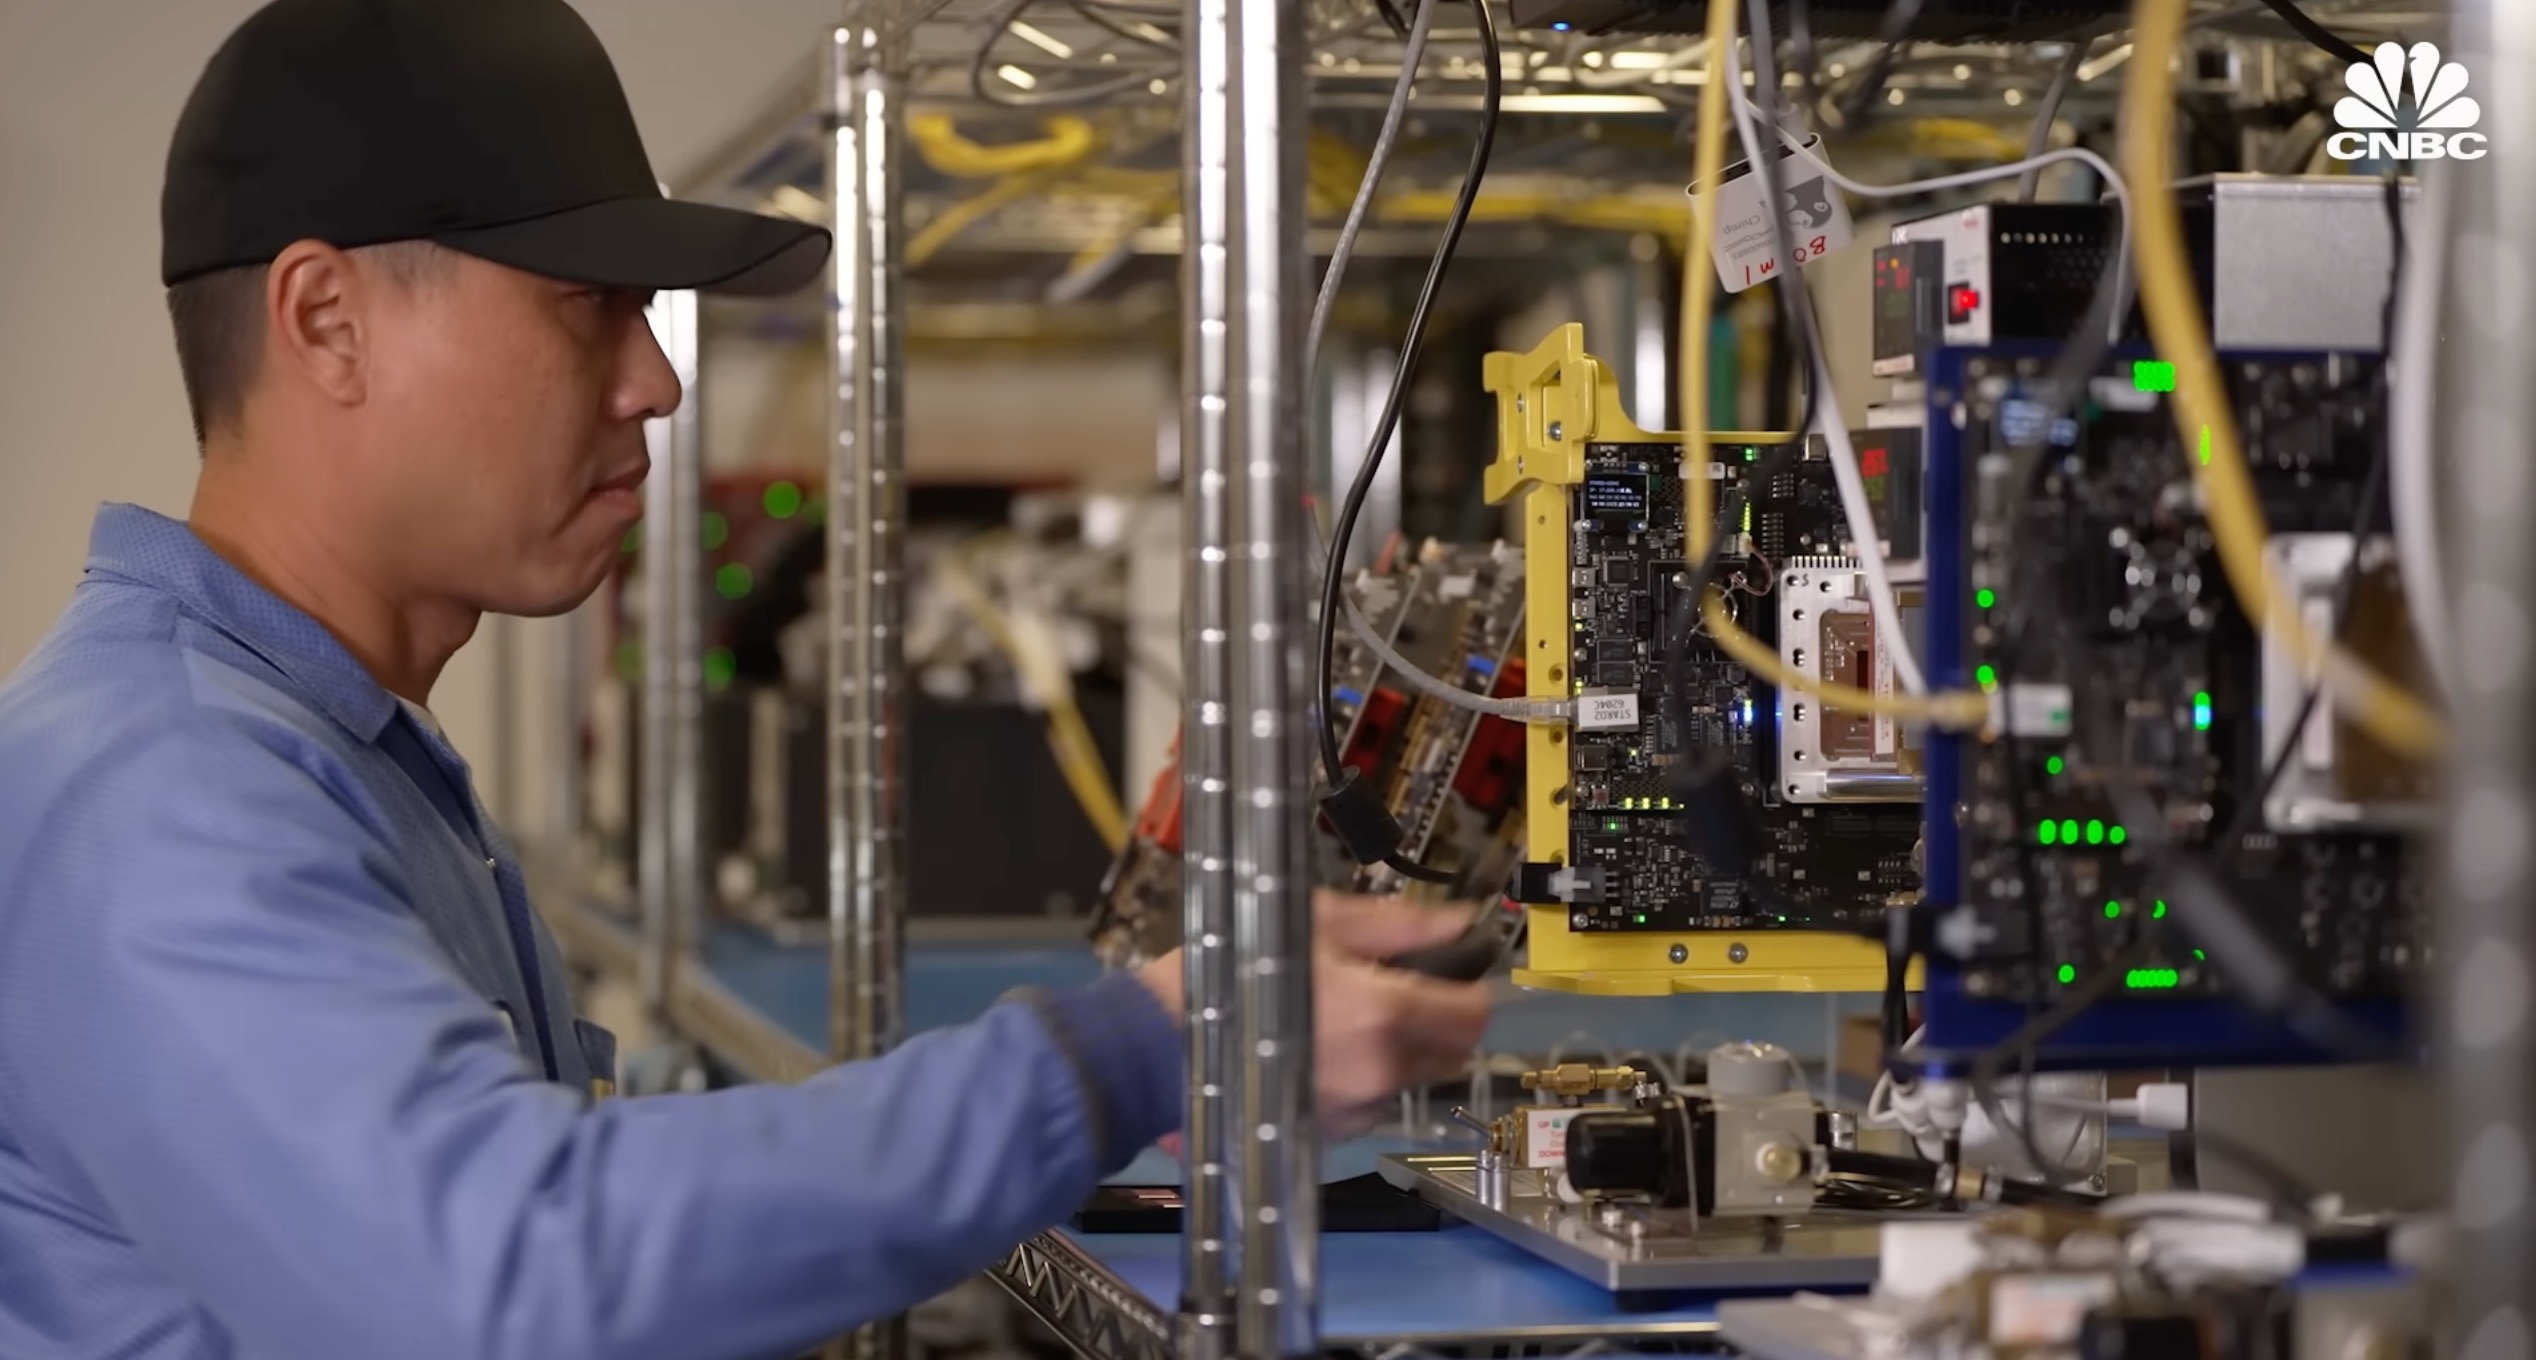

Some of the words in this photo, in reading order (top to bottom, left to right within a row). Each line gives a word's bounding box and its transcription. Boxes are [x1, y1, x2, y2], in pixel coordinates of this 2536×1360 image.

[1723, 214, 1760, 235] Chimp
[1801, 573, 1810, 587] S
[1538, 1120, 1550, 1129] UP
